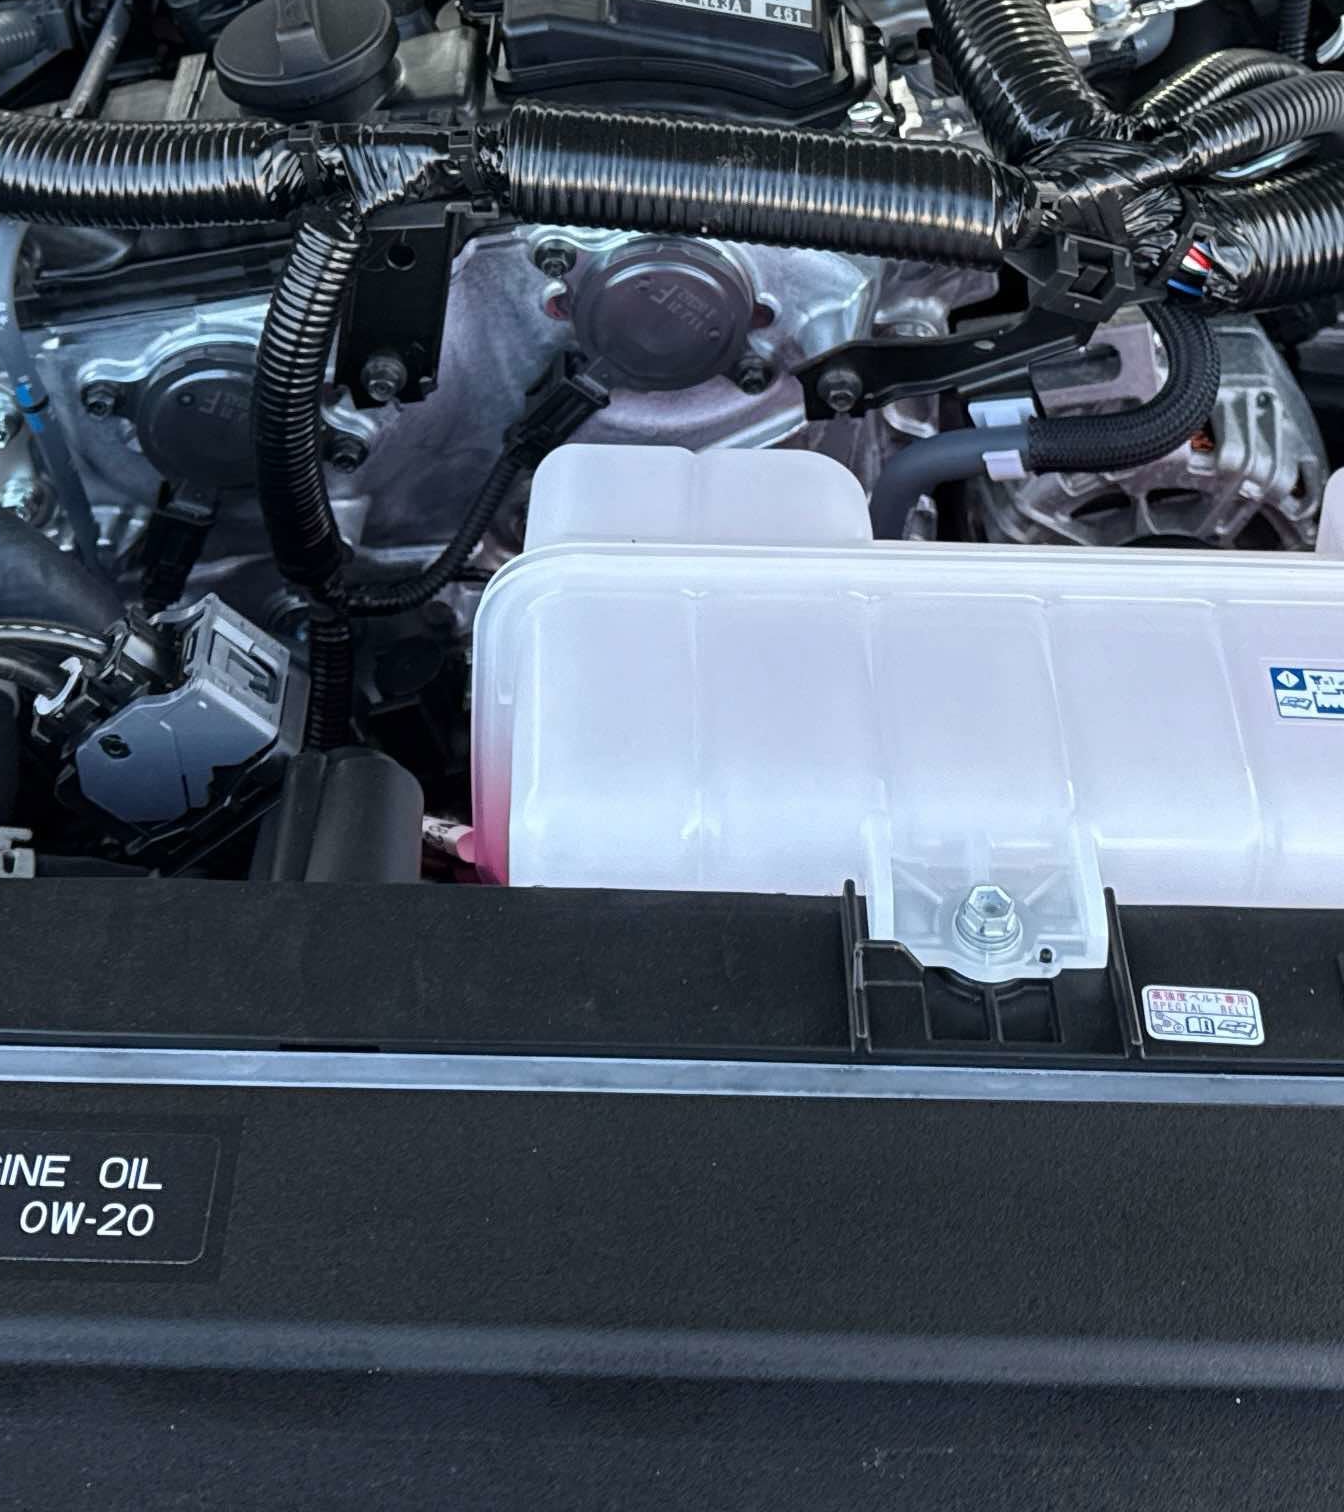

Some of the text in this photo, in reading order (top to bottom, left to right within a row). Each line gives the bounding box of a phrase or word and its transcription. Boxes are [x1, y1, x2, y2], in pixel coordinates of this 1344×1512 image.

[773, 9, 803, 24] 461
[98, 1157, 163, 1190] OIL
[19, 1200, 155, 1237] 0W-20
